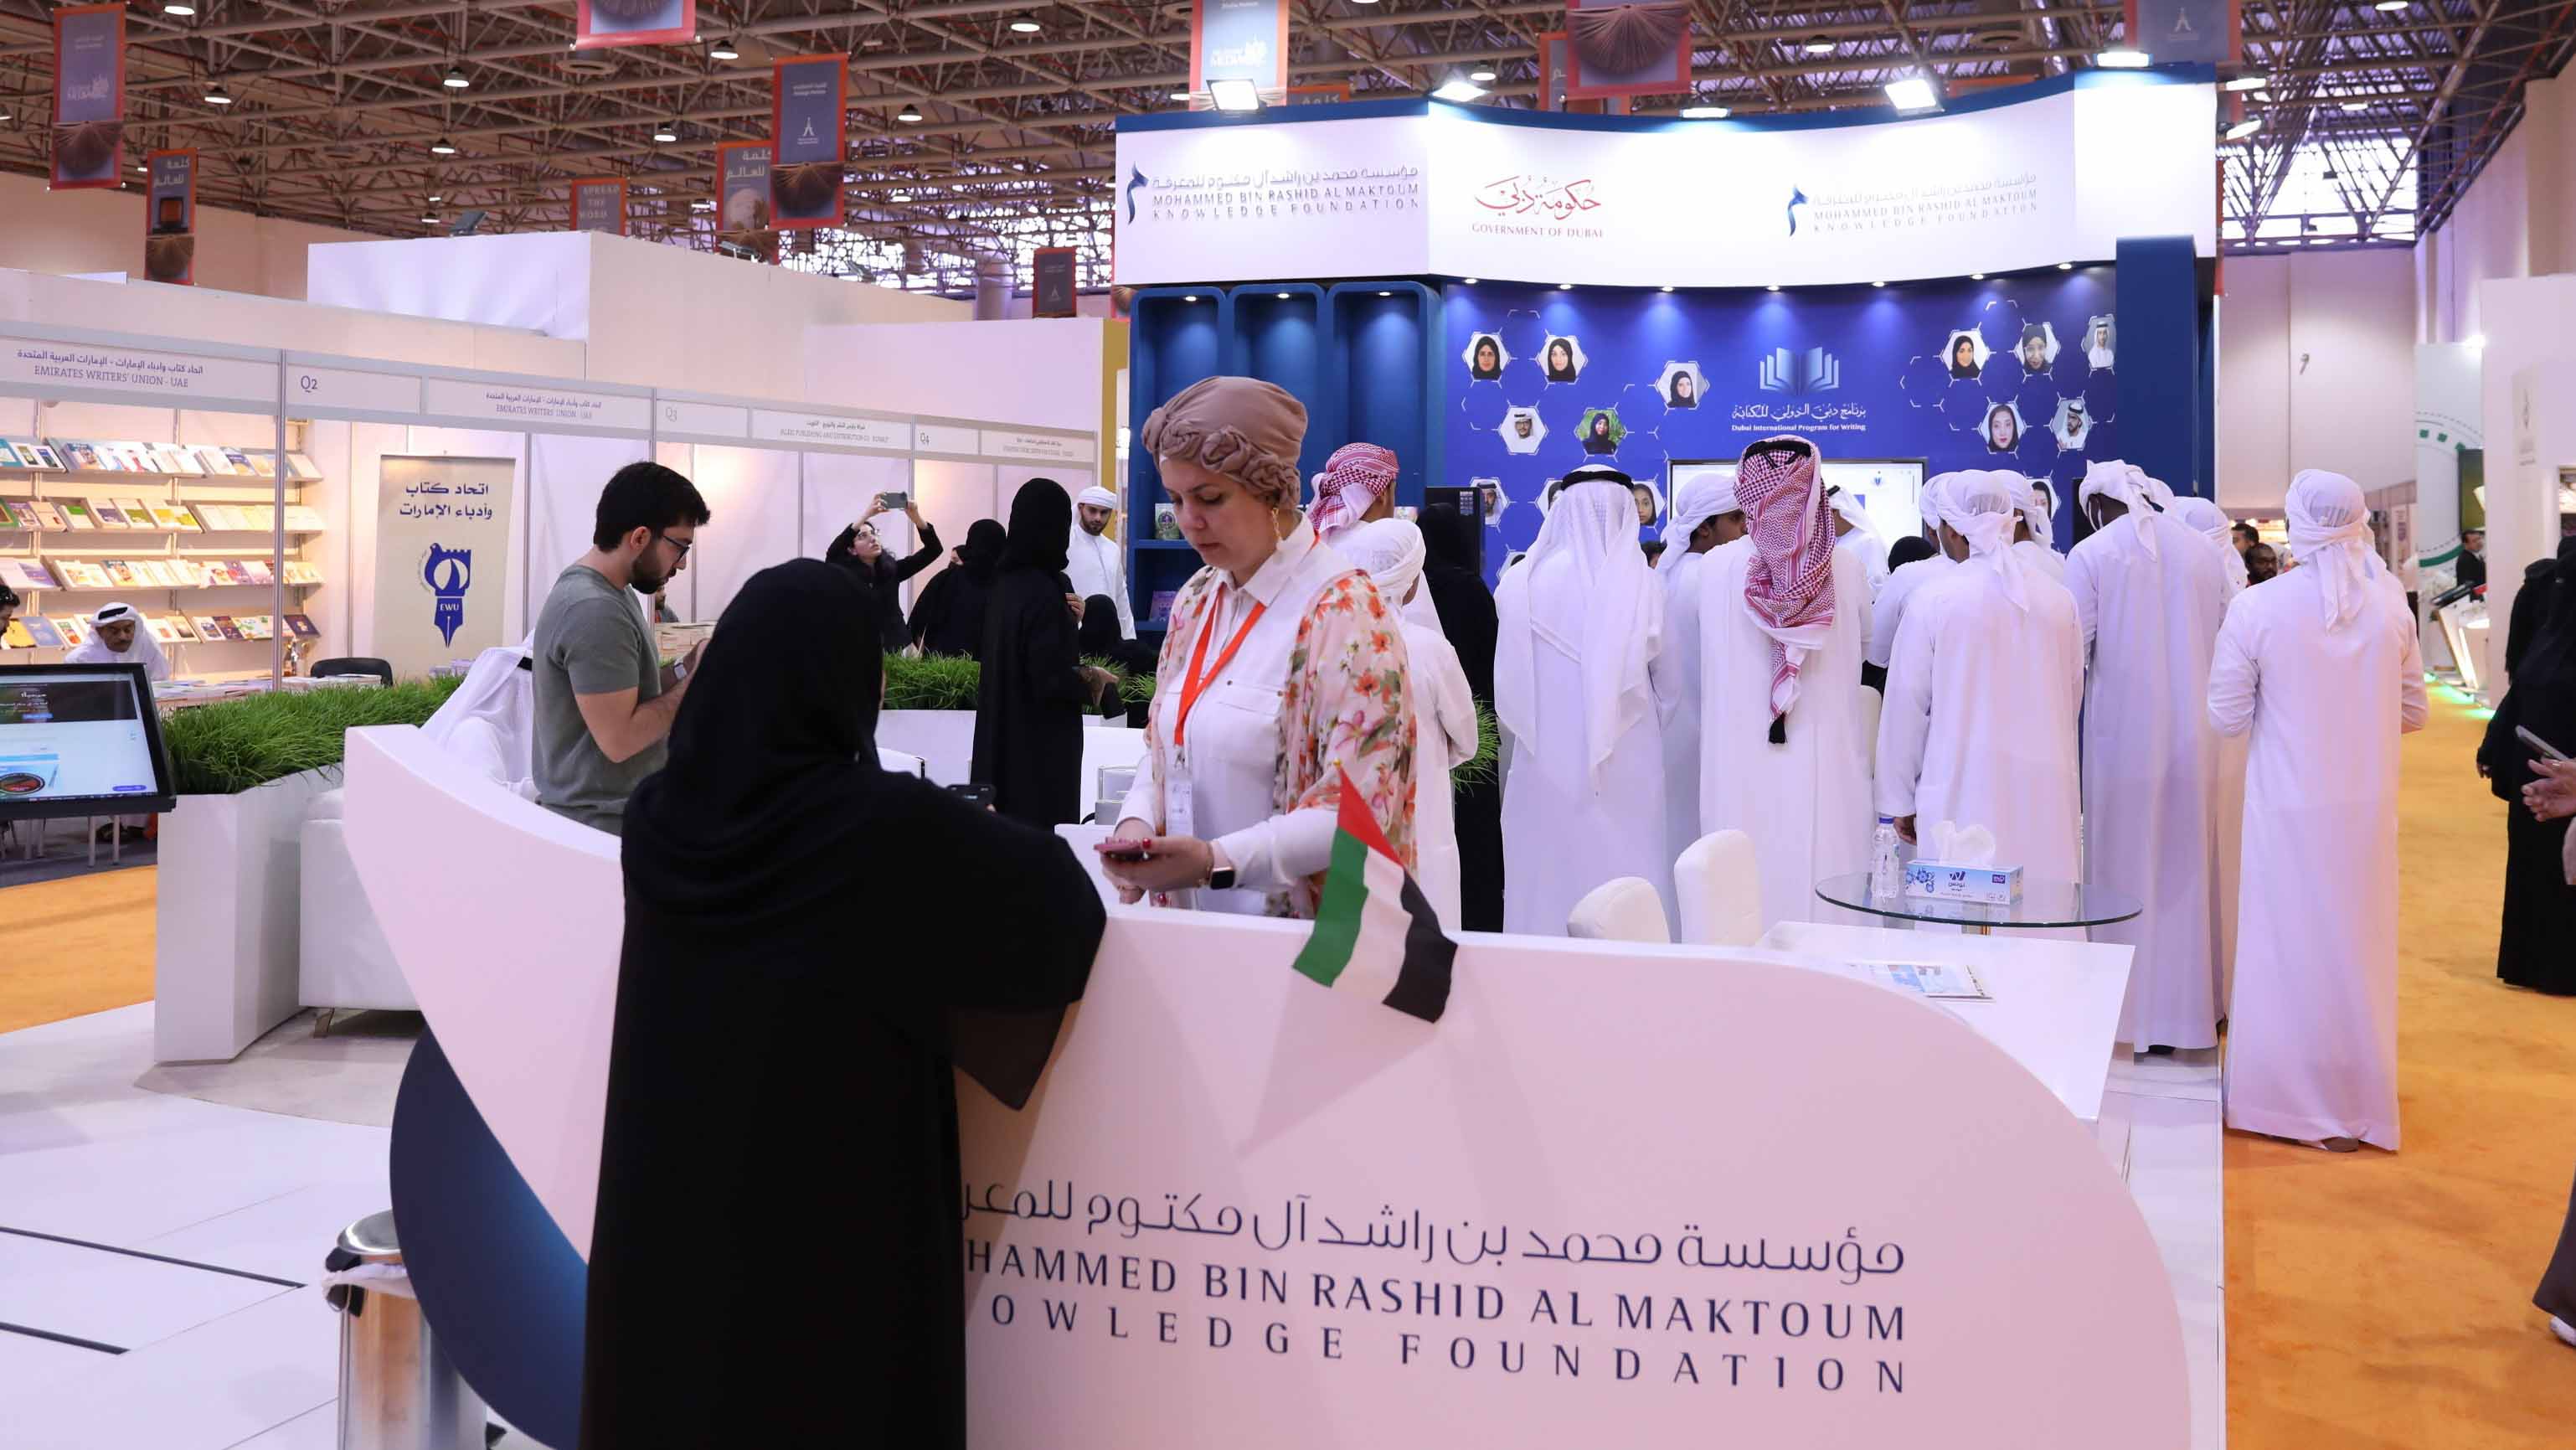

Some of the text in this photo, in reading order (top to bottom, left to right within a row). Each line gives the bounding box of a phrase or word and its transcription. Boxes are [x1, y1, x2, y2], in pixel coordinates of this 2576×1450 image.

[1322, 170, 1358, 181] محمد
[1361, 164, 1419, 179] مؤسسة
[1153, 183, 1419, 206] MOHAMMED BIN RASHID AL MAKTOUM
[1153, 199, 1419, 221] KNOWLEDGE FOUNDATION
[1471, 223, 1604, 238] GOVERNMENT OF DUBAI
[17, 349, 48, 360] المتحدة
[50, 352, 75, 364] العربية
[167, 363, 185, 373] كتاب
[34, 365, 84, 379] EMIRATES
[86, 369, 130, 383] WRITERS'
[131, 374, 163, 385] UNION
[171, 376, 188, 388] UAE
[301, 374, 318, 394] Q2
[1799, 424, 1827, 432] Program
[1841, 423, 1866, 431] Writing
[405, 482, 488, 498] اتحاد كتاب
[399, 503, 493, 520] وأدباء الإمارات
[440, 603, 460, 611] EWU
[961, 1179, 1904, 1285] مؤسسة محمد بن راشد آل مكتوم للمعر
[967, 1239, 1904, 1340] HAMMED BIN RASHID AL MAKTOUM
[992, 1293, 1904, 1393] OWLEDGE FOUNDATION
